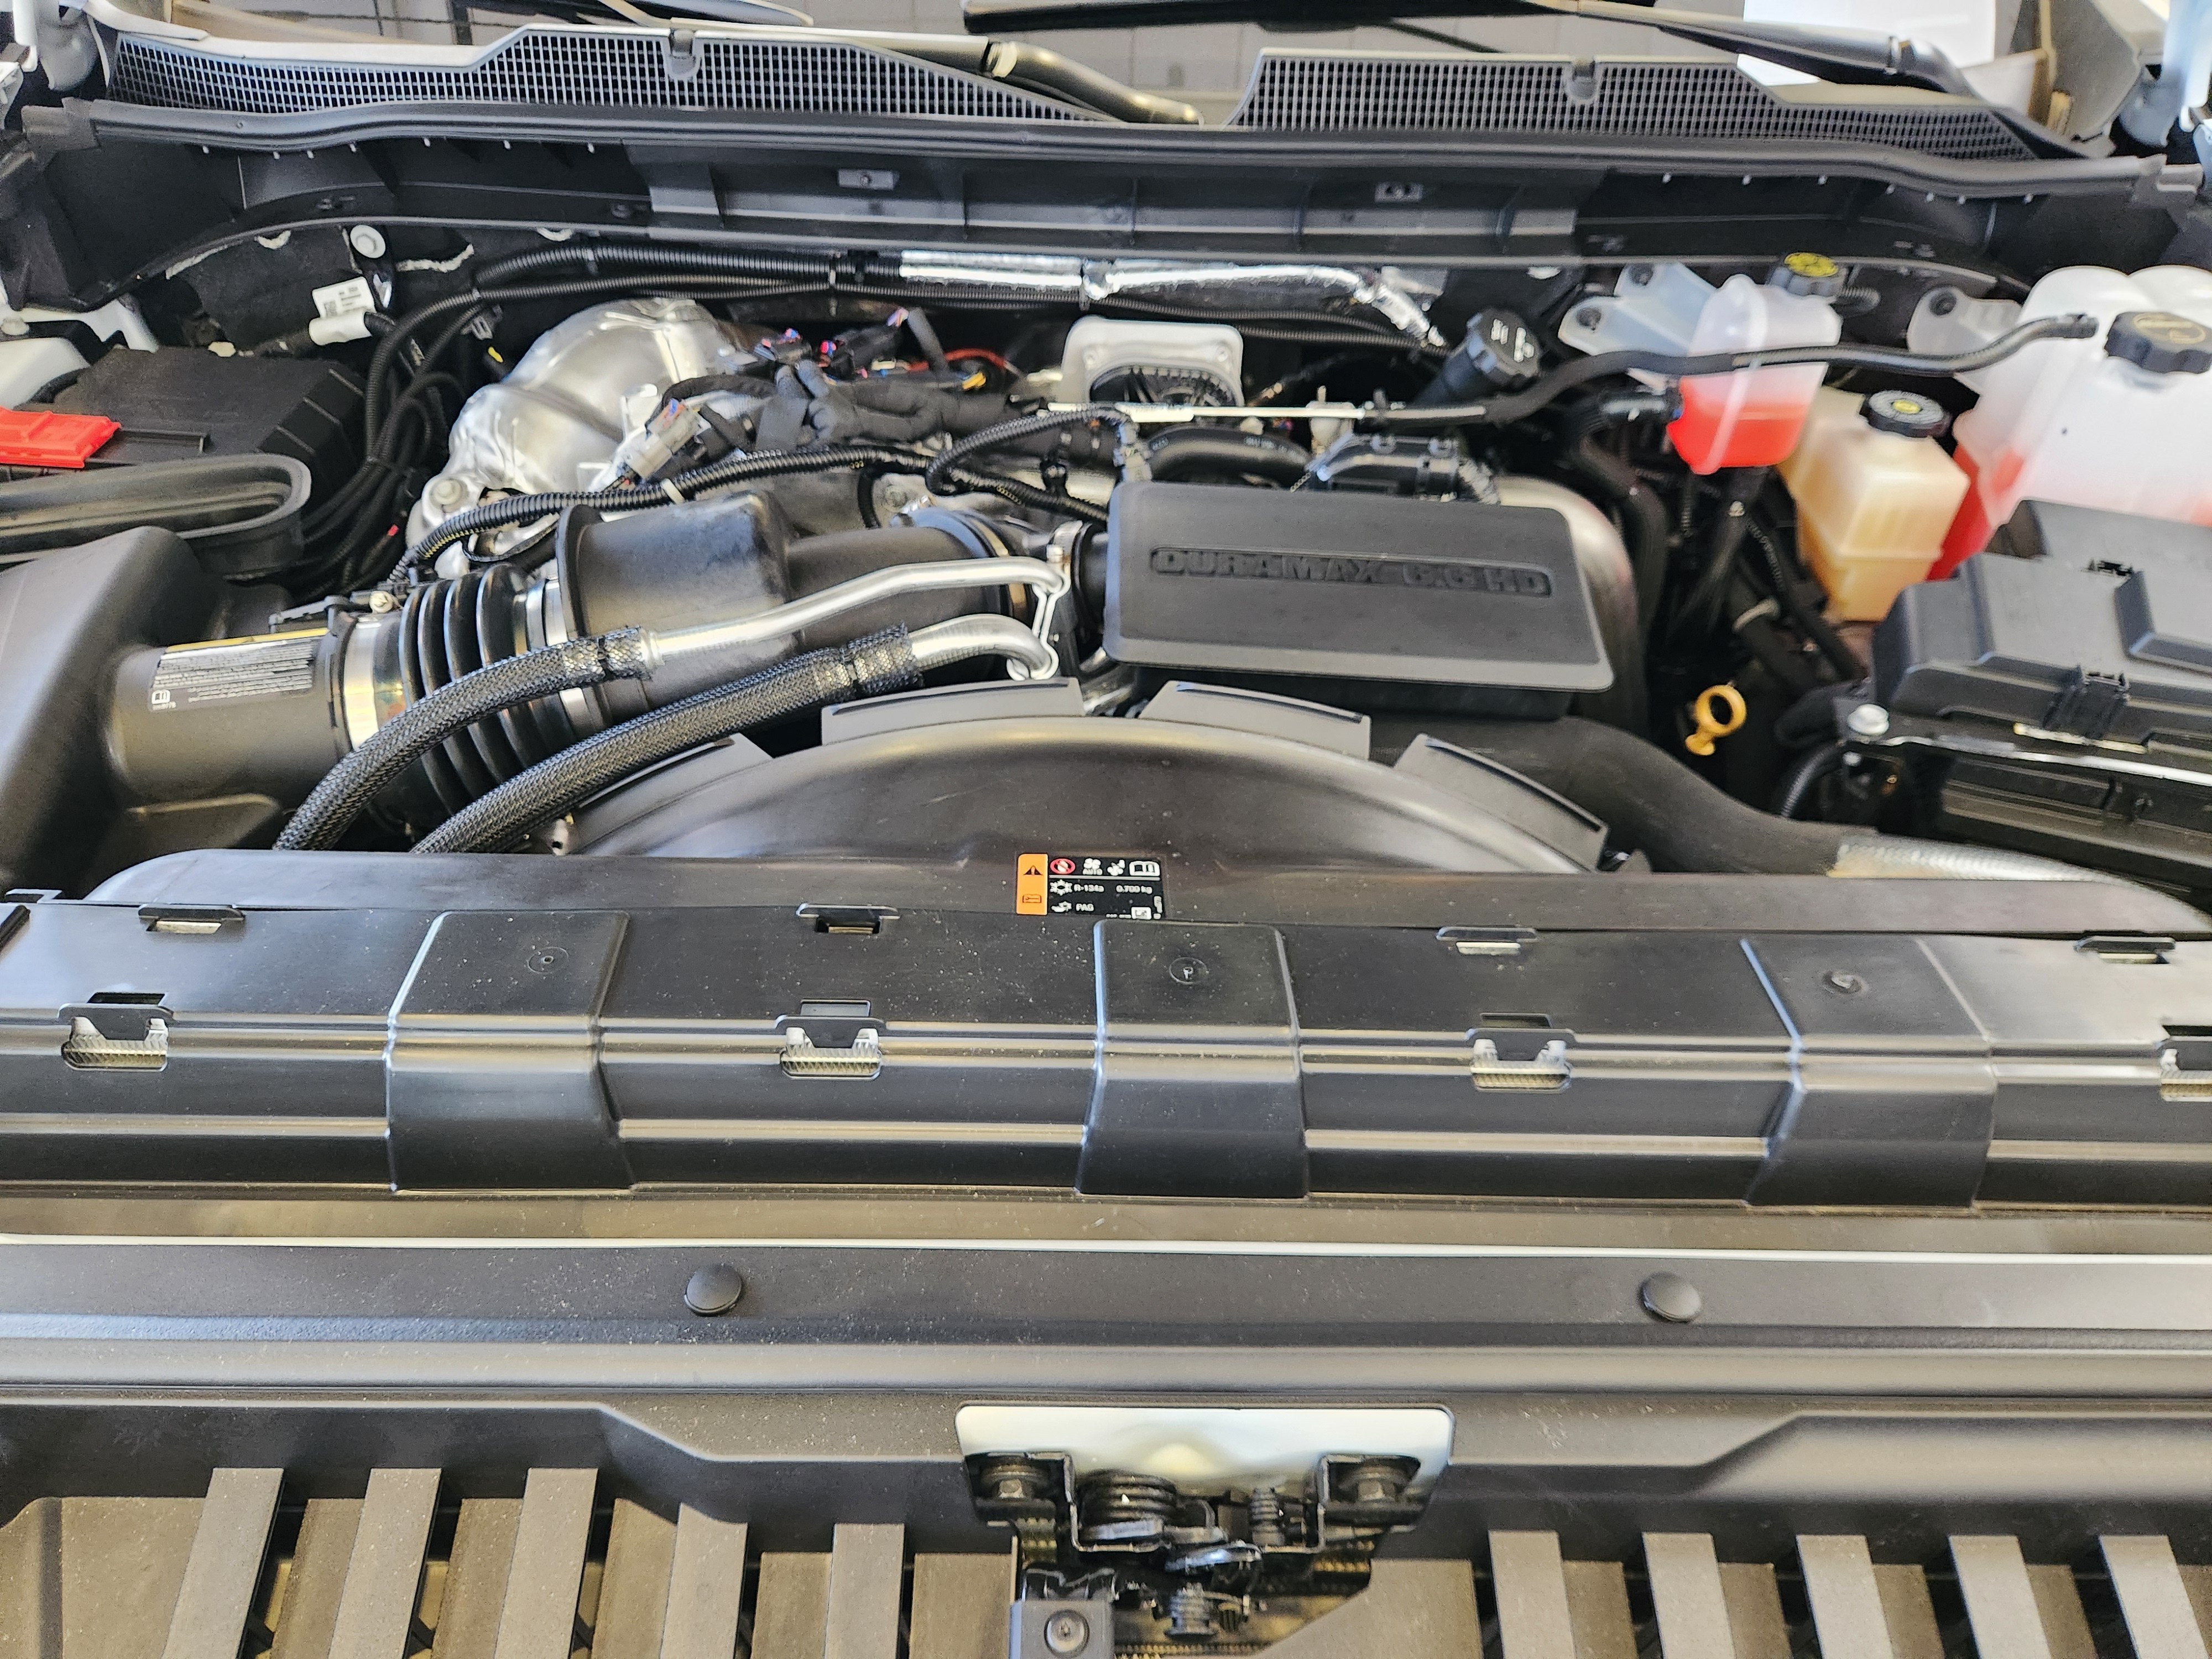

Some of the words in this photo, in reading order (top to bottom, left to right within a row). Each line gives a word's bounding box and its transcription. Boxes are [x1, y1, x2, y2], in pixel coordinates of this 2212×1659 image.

[1155, 550, 1383, 585] DURAMAX
[1484, 568, 1551, 597] HD
[1076, 903, 1094, 912] PAG
